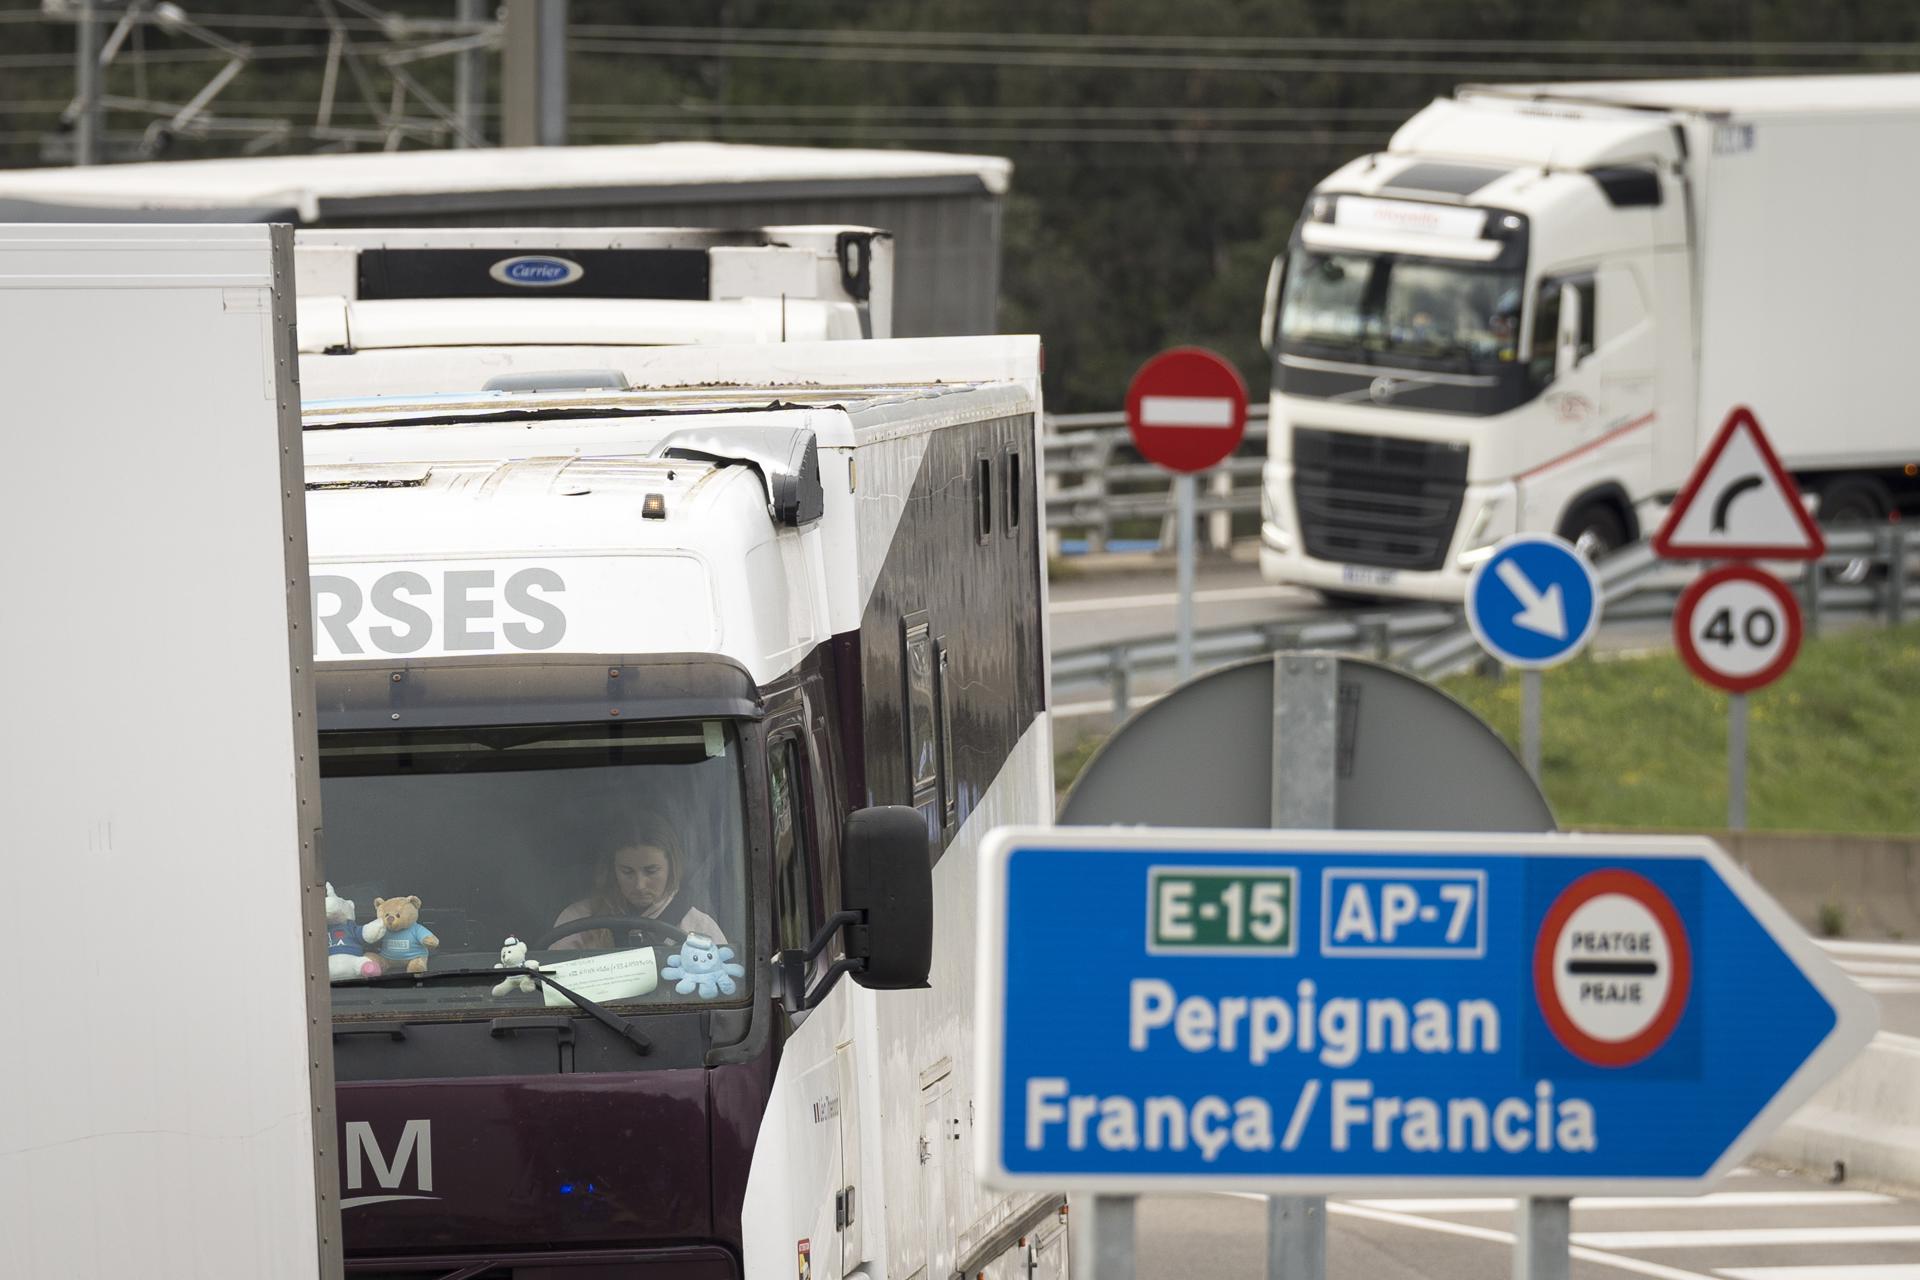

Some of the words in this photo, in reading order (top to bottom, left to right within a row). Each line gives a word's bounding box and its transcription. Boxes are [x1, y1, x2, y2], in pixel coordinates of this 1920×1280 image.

[511, 263, 562, 278] Carrier
[1701, 606, 1776, 649] 40
[1159, 881, 1286, 941] E-15
[1334, 883, 1475, 943] AP-7
[1571, 931, 1653, 954] PEATGE
[1579, 982, 1642, 1004] PEAJE
[1130, 979, 1499, 1067] Perpignan
